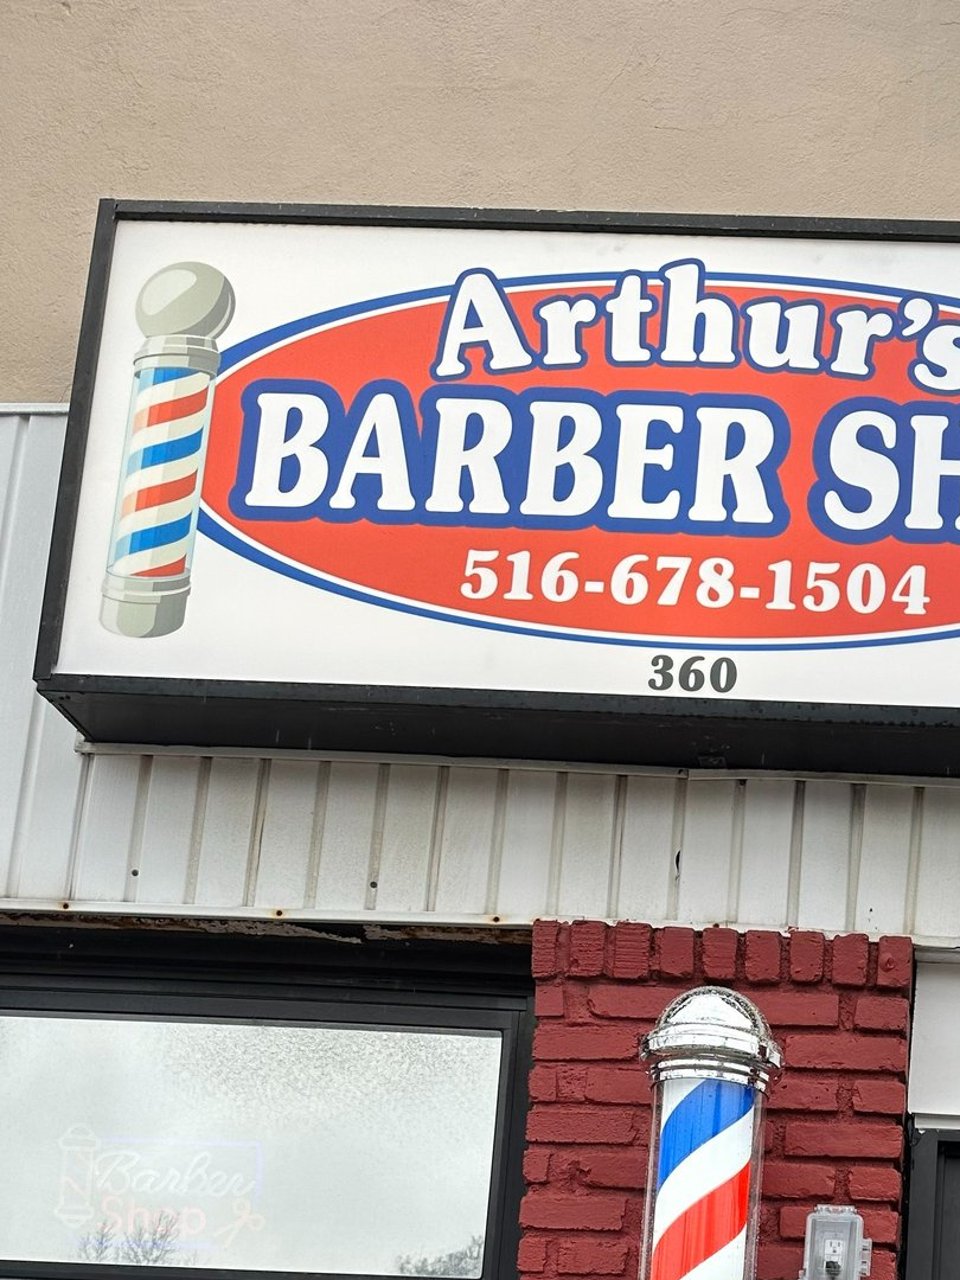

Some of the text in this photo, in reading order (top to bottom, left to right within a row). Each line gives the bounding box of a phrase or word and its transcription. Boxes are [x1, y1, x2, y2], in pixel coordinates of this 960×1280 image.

[243, 391, 776, 524] BARBER
[460, 549, 930, 615] 516-678-1504
[647, 654, 738, 693] 360
[96, 1150, 256, 1197] Barber
[98, 1196, 206, 1237] Shop
